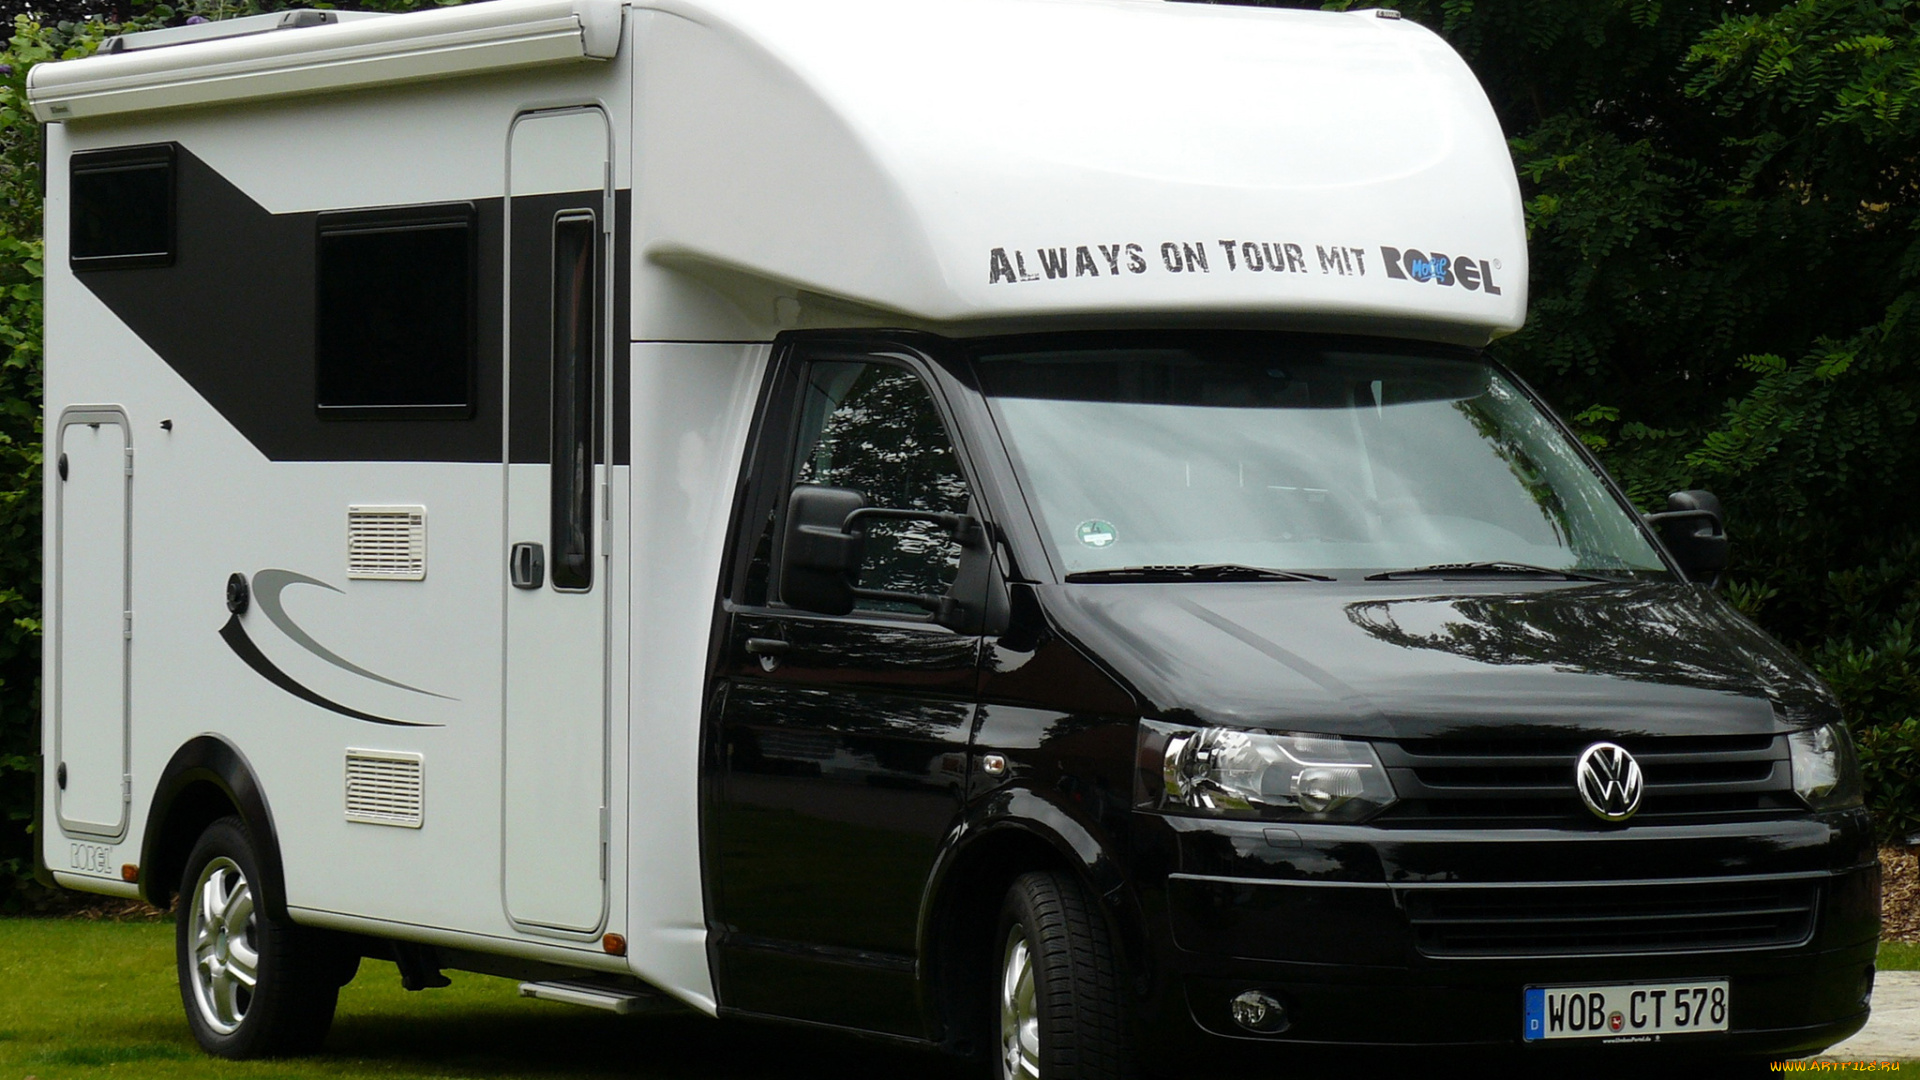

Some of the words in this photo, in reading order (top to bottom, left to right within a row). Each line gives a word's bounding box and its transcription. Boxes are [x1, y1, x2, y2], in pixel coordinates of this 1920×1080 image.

[989, 243, 1147, 284] ALWAYS
[1160, 241, 1210, 273] ON
[1218, 239, 1308, 273] TOUR
[1315, 244, 1365, 277] MIT
[1380, 246, 1501, 296] ROBEL
[71, 843, 112, 874] ROBEL
[1531, 1019, 1539, 1030] D
[1548, 992, 1605, 1032] WOB
[1630, 990, 1667, 1028] CT
[1674, 987, 1725, 1027] 578
